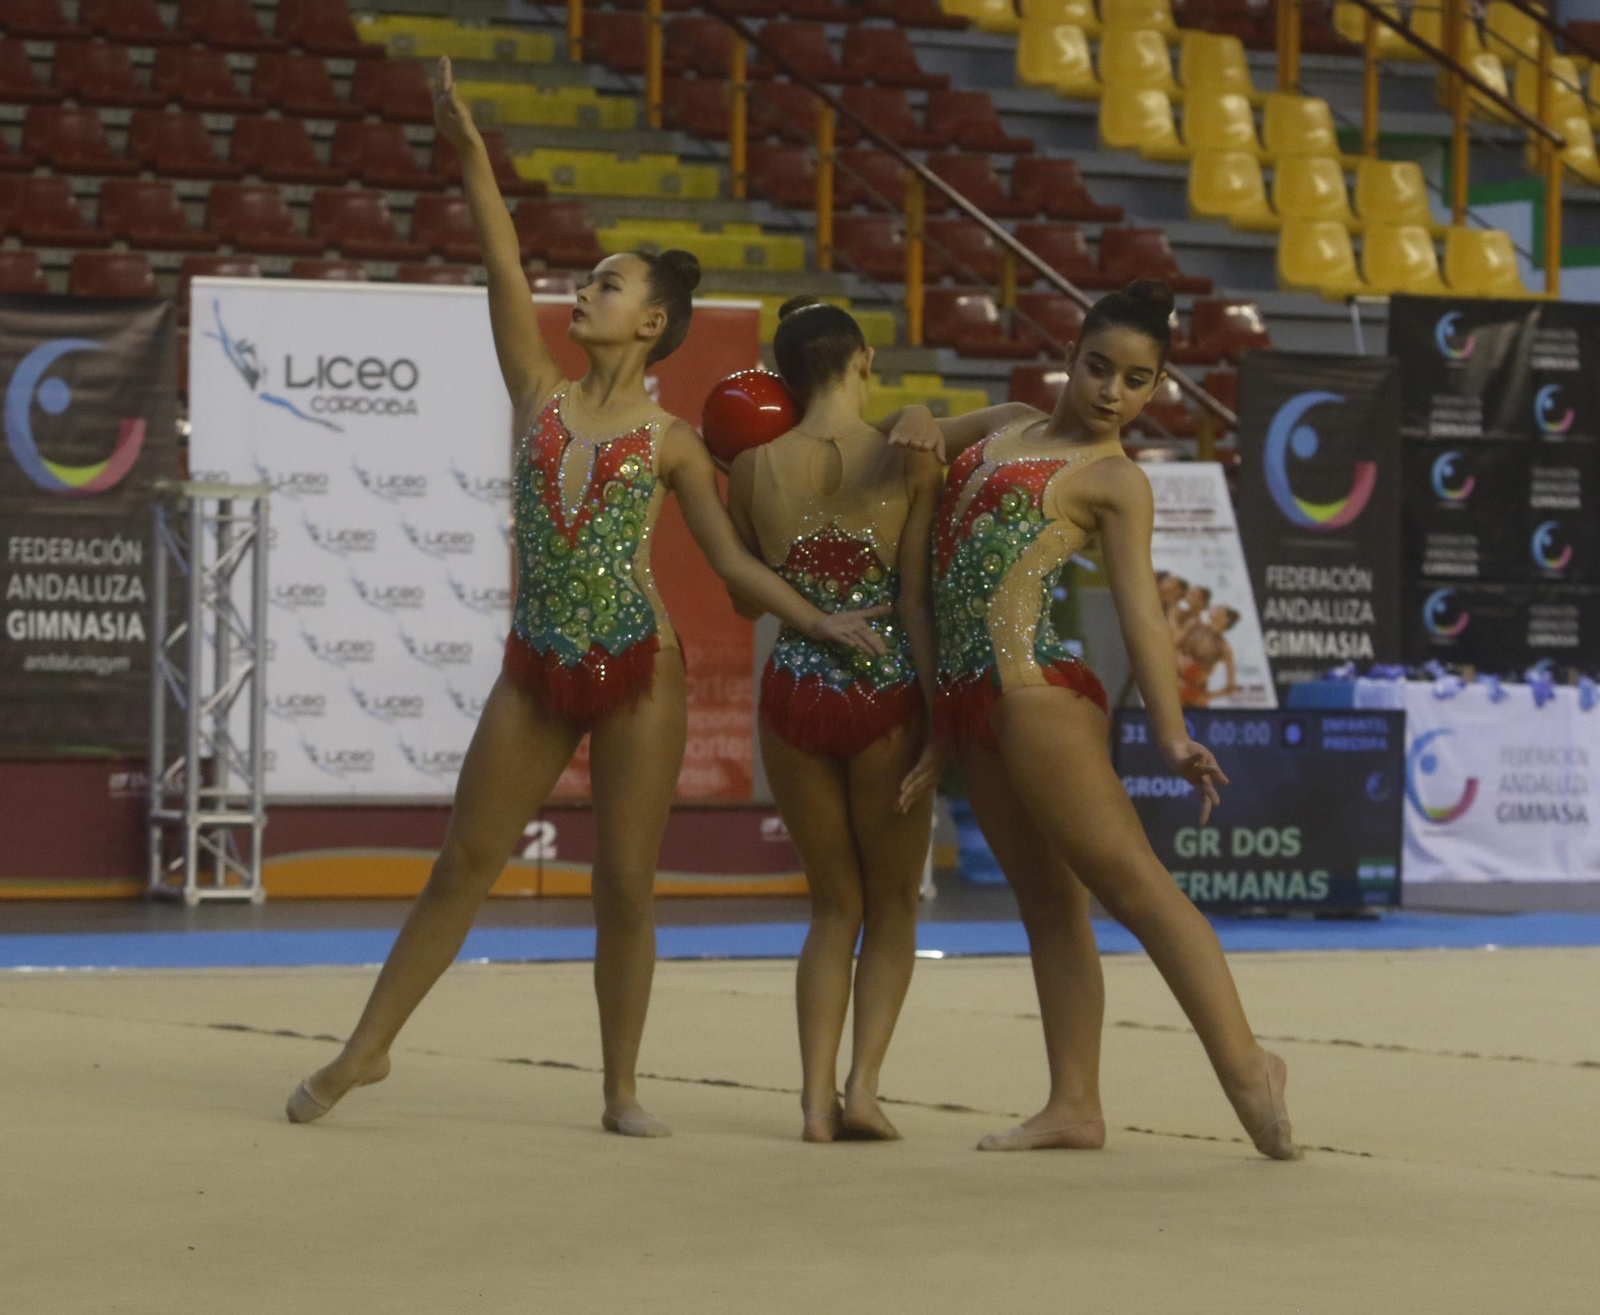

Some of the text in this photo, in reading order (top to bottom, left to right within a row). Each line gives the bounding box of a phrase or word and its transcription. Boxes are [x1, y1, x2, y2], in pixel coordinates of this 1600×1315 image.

[8, 533, 143, 566] FEDERACIÓN
[6, 572, 146, 603] ANDALUZA
[6, 609, 146, 642] GIMNASIA
[1263, 597, 1375, 625] ANDALUZA
[1264, 629, 1375, 659] GIMNASIA
[1208, 721, 1271, 745] 00:00
[522, 820, 557, 859] 2
[1174, 826, 1301, 858] GR DOS
